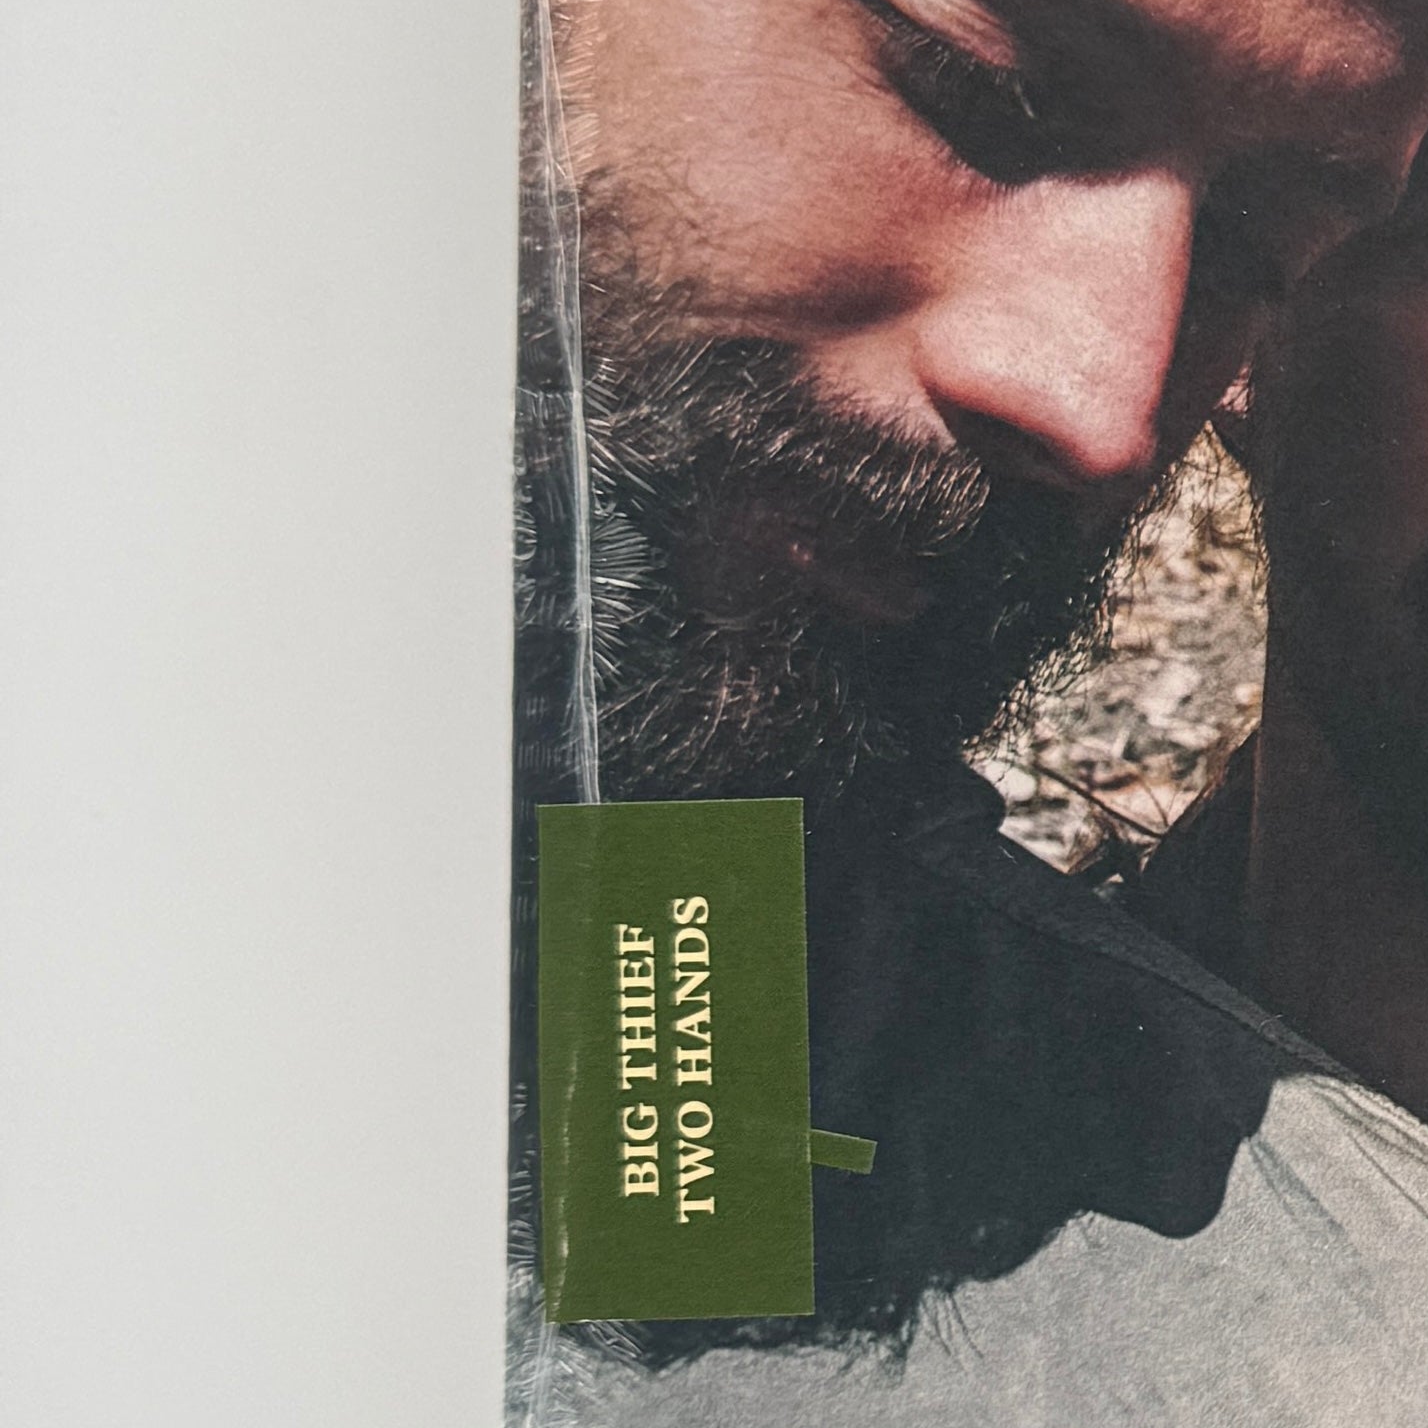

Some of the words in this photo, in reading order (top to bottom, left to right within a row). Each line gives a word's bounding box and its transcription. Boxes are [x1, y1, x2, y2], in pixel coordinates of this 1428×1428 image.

[618, 923, 657, 1090] THIEF
[673, 896, 713, 1087] HANDS
[622, 1102, 660, 1197] BIG
[677, 1100, 715, 1224] TWO
